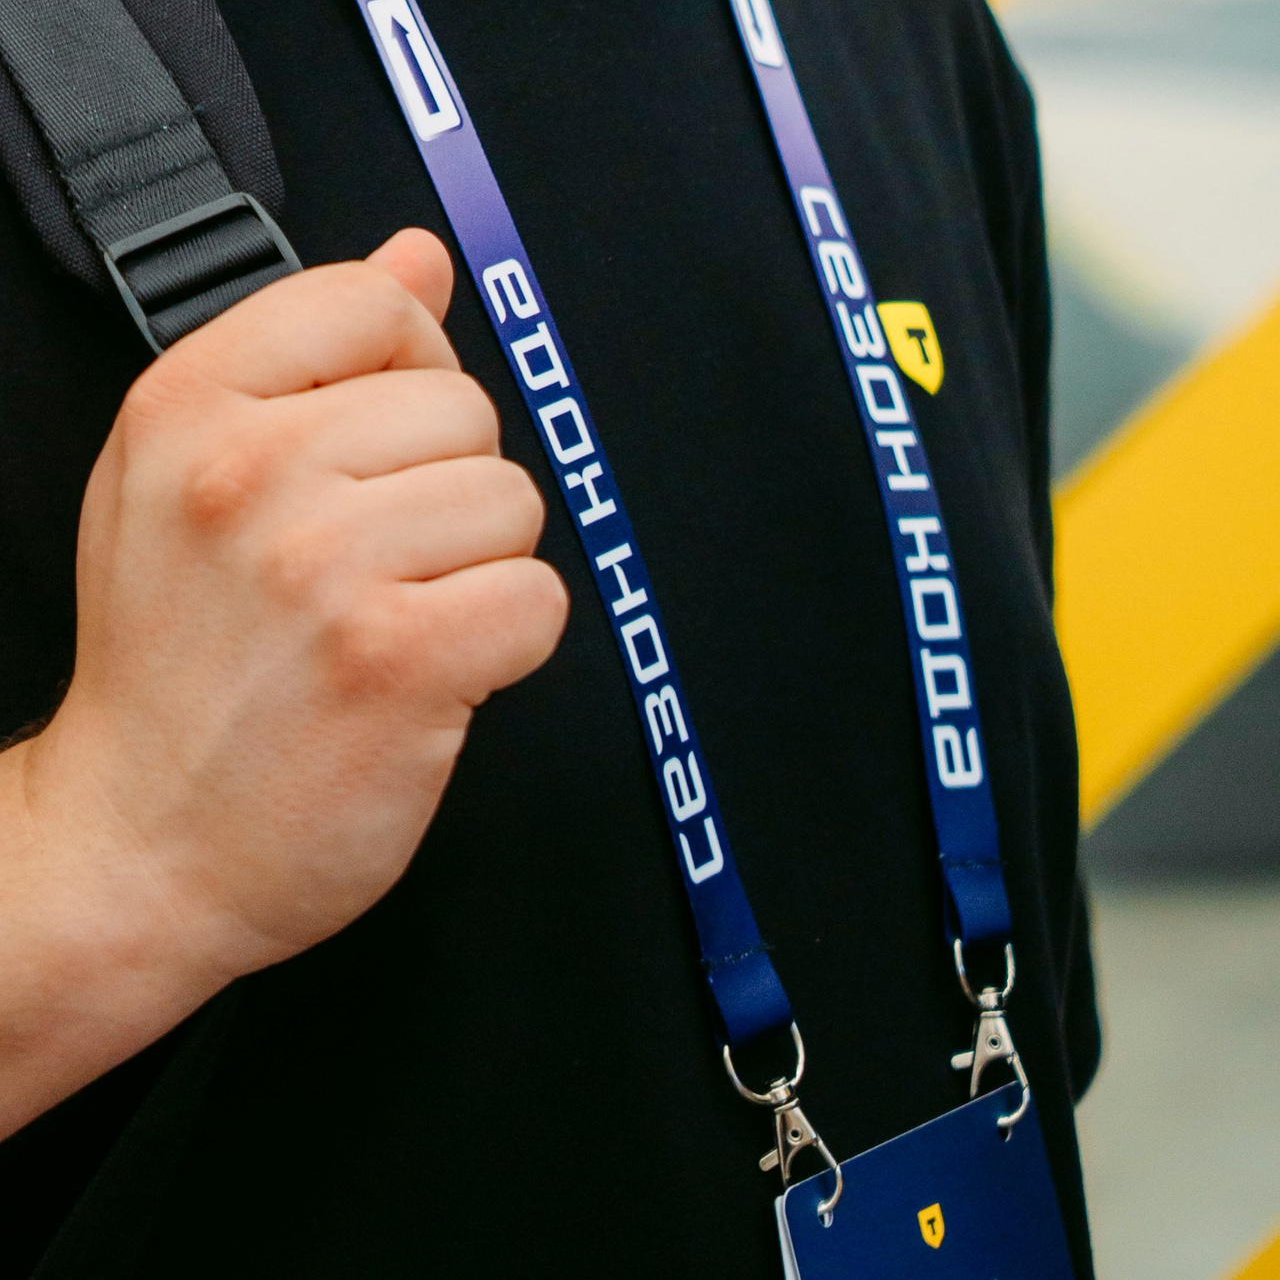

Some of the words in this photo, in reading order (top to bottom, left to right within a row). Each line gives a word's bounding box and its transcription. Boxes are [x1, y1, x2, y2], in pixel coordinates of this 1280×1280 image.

[482, 258, 617, 527] кода
[800, 186, 929, 490] сезон
[899, 517, 983, 787] кода
[594, 542, 724, 885] сезон
